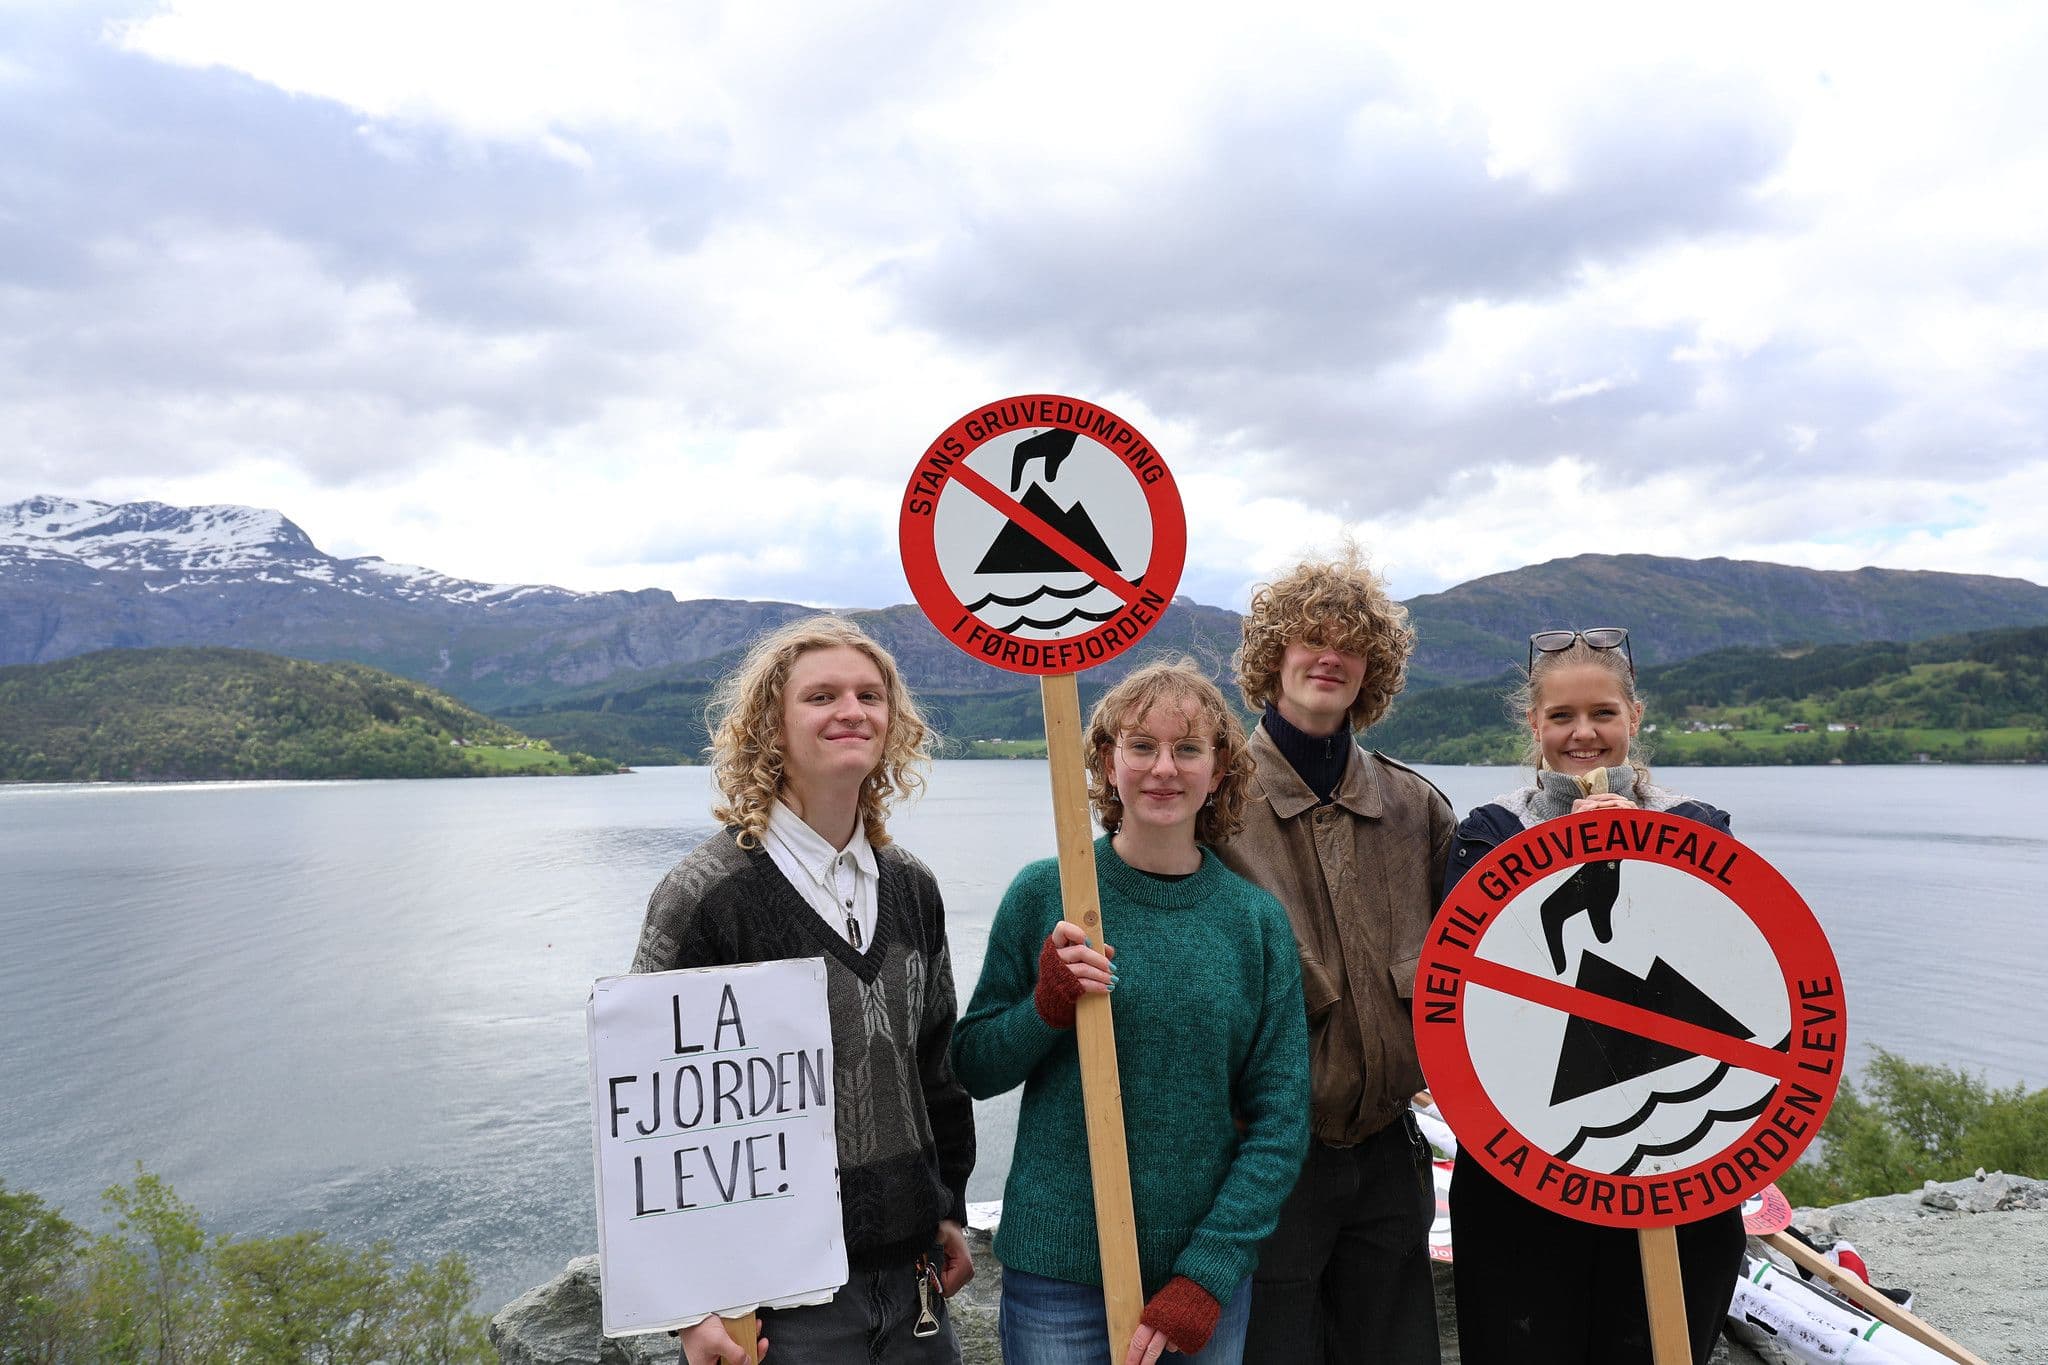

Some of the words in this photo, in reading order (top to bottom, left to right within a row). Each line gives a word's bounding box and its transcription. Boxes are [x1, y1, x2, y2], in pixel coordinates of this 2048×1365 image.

[909, 437, 966, 516] STANS
[964, 400, 1165, 486] GRUVEDUMPING
[952, 615, 969, 634] I
[966, 589, 1166, 668] FØRDEFJORDEN
[1477, 819, 1740, 902] GRUVEAVFALL
[1438, 905, 1488, 951] TIL
[672, 983, 747, 1054] LA
[1425, 962, 1461, 1024] NEI
[608, 1048, 827, 1138] FJORDEN
[1483, 1127, 1530, 1178] LA
[1536, 1082, 1823, 1217] FØRDEFJORDEN
[1797, 975, 1837, 1076] LEVE
[633, 1132, 790, 1217] LEVE!
